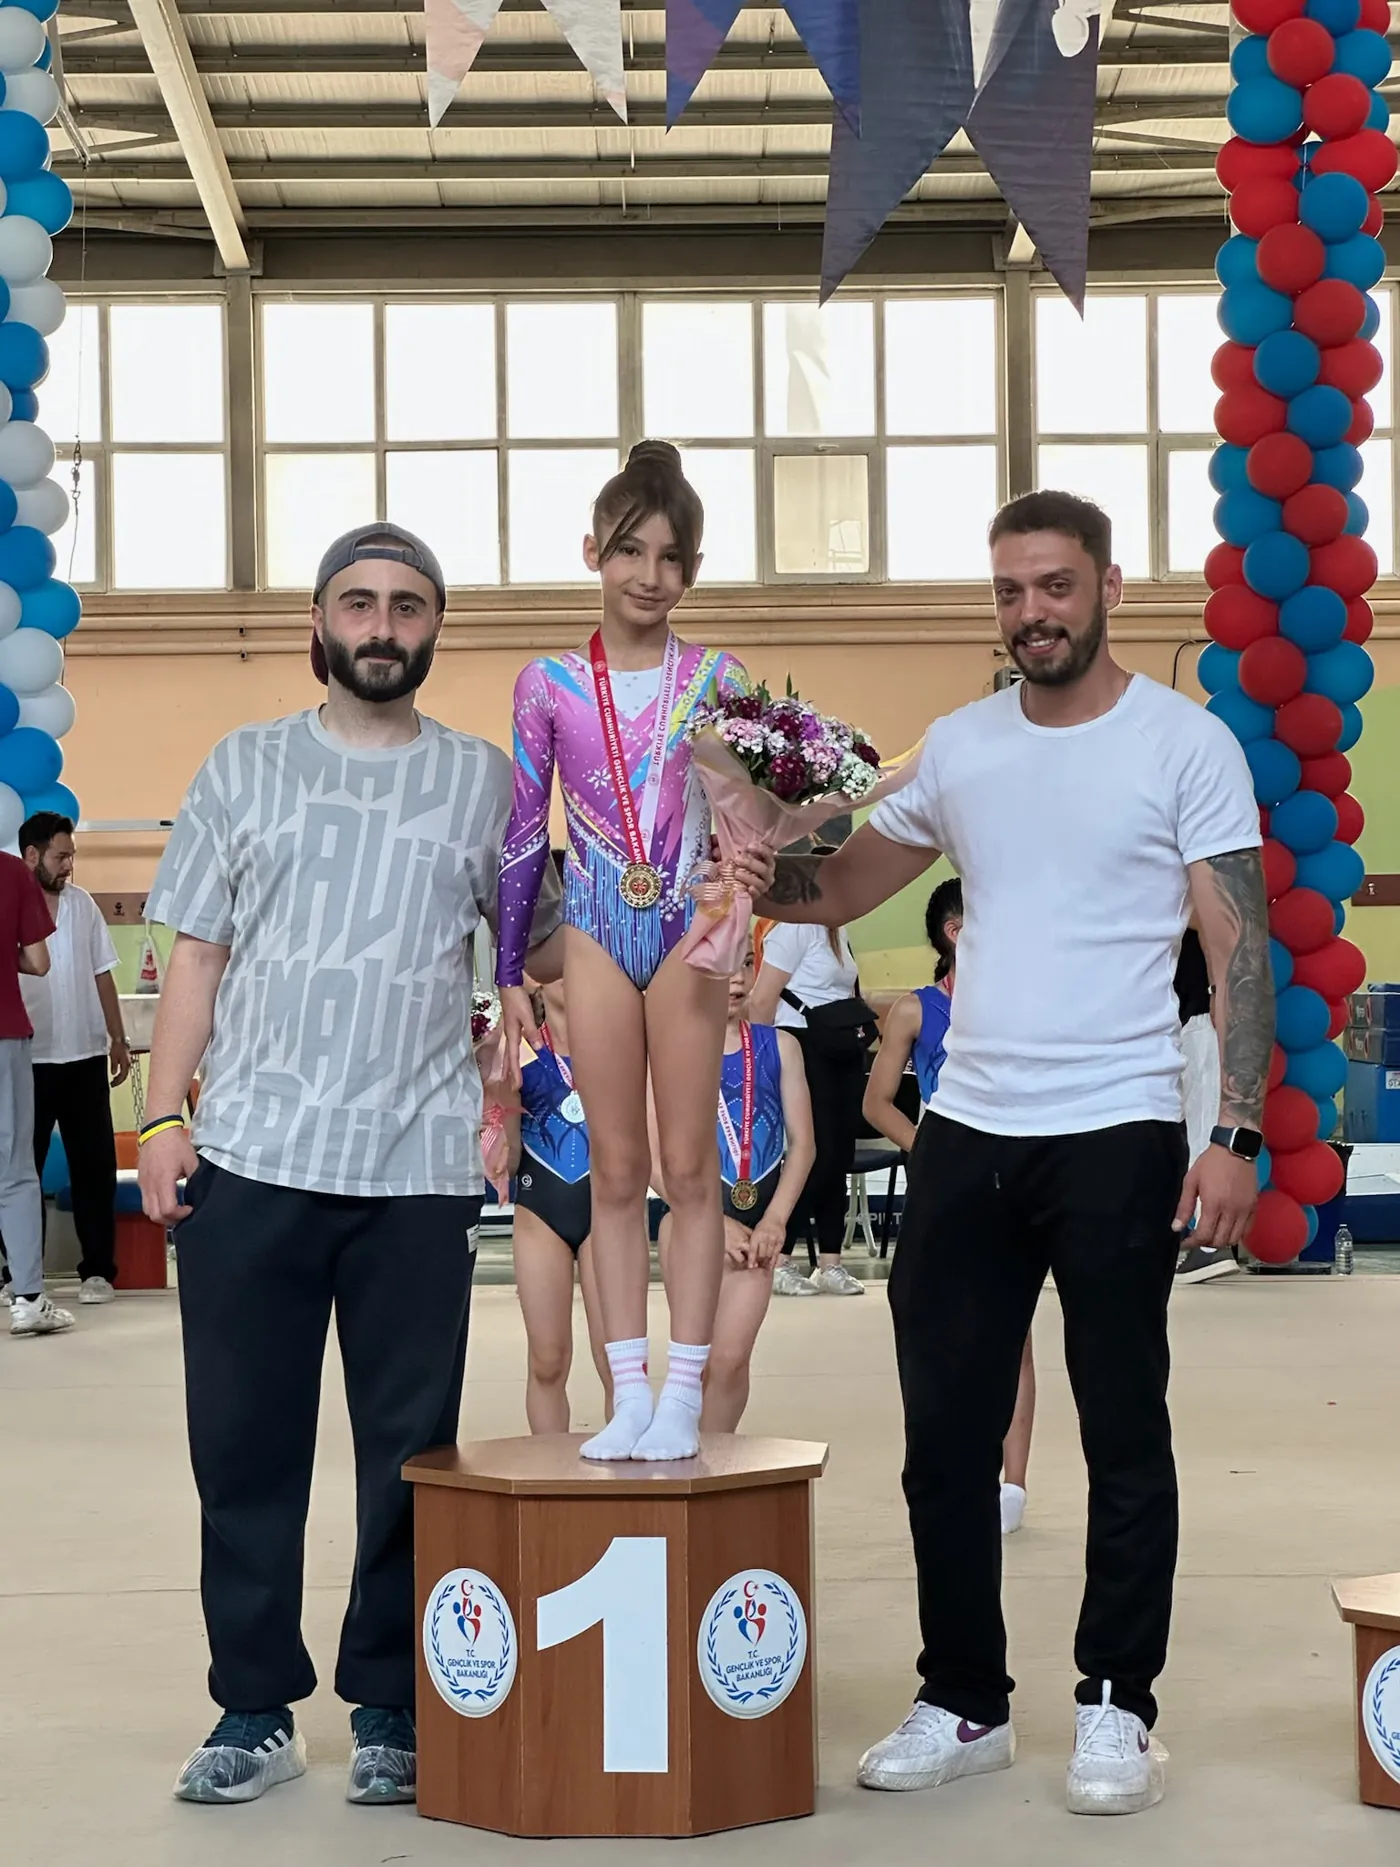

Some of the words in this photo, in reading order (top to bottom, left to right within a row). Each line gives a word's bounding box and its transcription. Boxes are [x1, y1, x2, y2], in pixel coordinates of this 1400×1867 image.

[598, 676, 609, 706] TÜRKİYE
[604, 707, 620, 757] CUMHURİYETİ
[613, 759, 628, 793] GENÇLİK
[621, 794, 630, 806] VE
[624, 806, 635, 829] SPOR
[629, 830, 643, 864] BAKANL
[447, 1658, 471, 1668] GENÇLİK
[473, 1659, 480, 1668] VE
[481, 1660, 496, 1668] SPOR
[537, 1537, 668, 1773] 1
[726, 1661, 754, 1674] GENÇLİK
[755, 1659, 763, 1667] VE
[765, 1655, 782, 1666] SPOR
[456, 1669, 488, 1678] BAKANLIĞI
[736, 1667, 773, 1682] BAKANLIĞI
